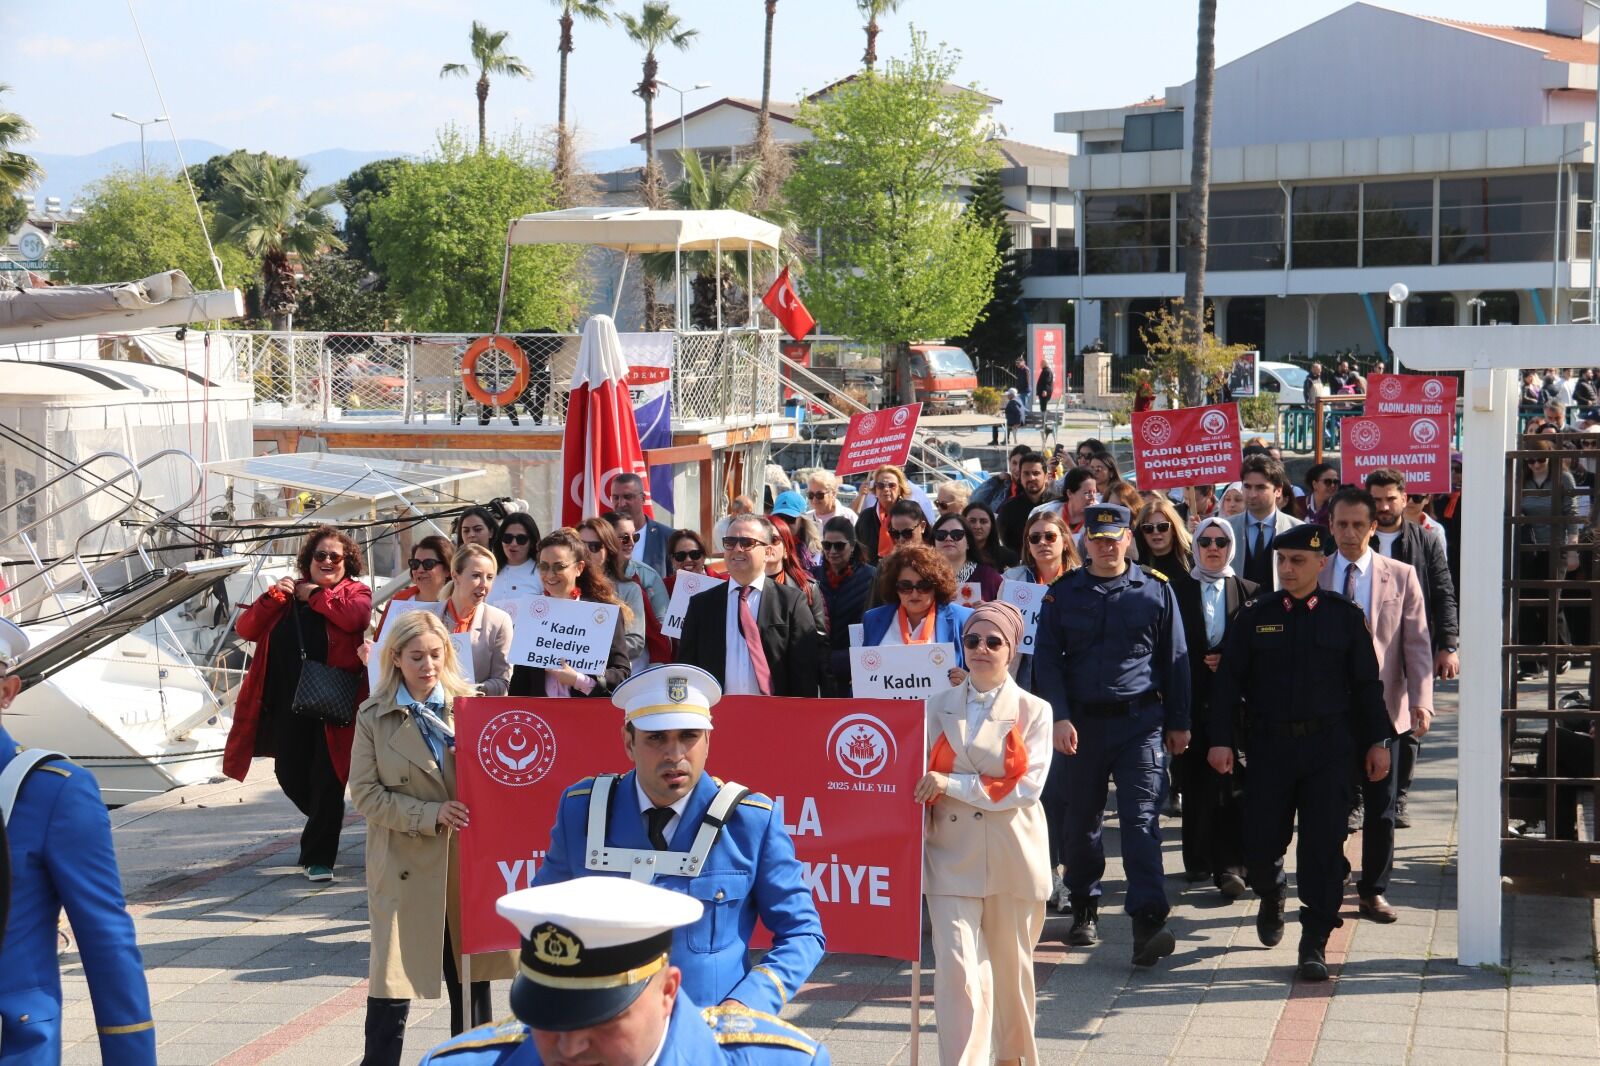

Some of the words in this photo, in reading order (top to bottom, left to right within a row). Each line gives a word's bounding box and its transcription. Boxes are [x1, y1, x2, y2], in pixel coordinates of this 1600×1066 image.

[1379, 402, 1423, 414] KADINLARIN
[850, 439, 873, 448] KADIN
[1142, 447, 1181, 457] KADIN
[1185, 441, 1233, 453] ÜRETİR
[848, 448, 880, 458] GELECEK
[882, 444, 903, 453] ONUN
[1144, 453, 1233, 468] DÖNÜŞTÜRÜR
[1355, 455, 1388, 466] KADIN
[1391, 453, 1436, 465] HAYATIN
[1152, 465, 1227, 480] İYİLEŞTİRİR
[1404, 470, 1431, 482] İNDE
[550, 622, 586, 637] Kadın
[535, 636, 590, 655] Belediye
[883, 673, 932, 689] Kadın
[827, 780, 849, 790] 2025
[851, 780, 874, 791] AİLE
[877, 783, 896, 793] YILI
